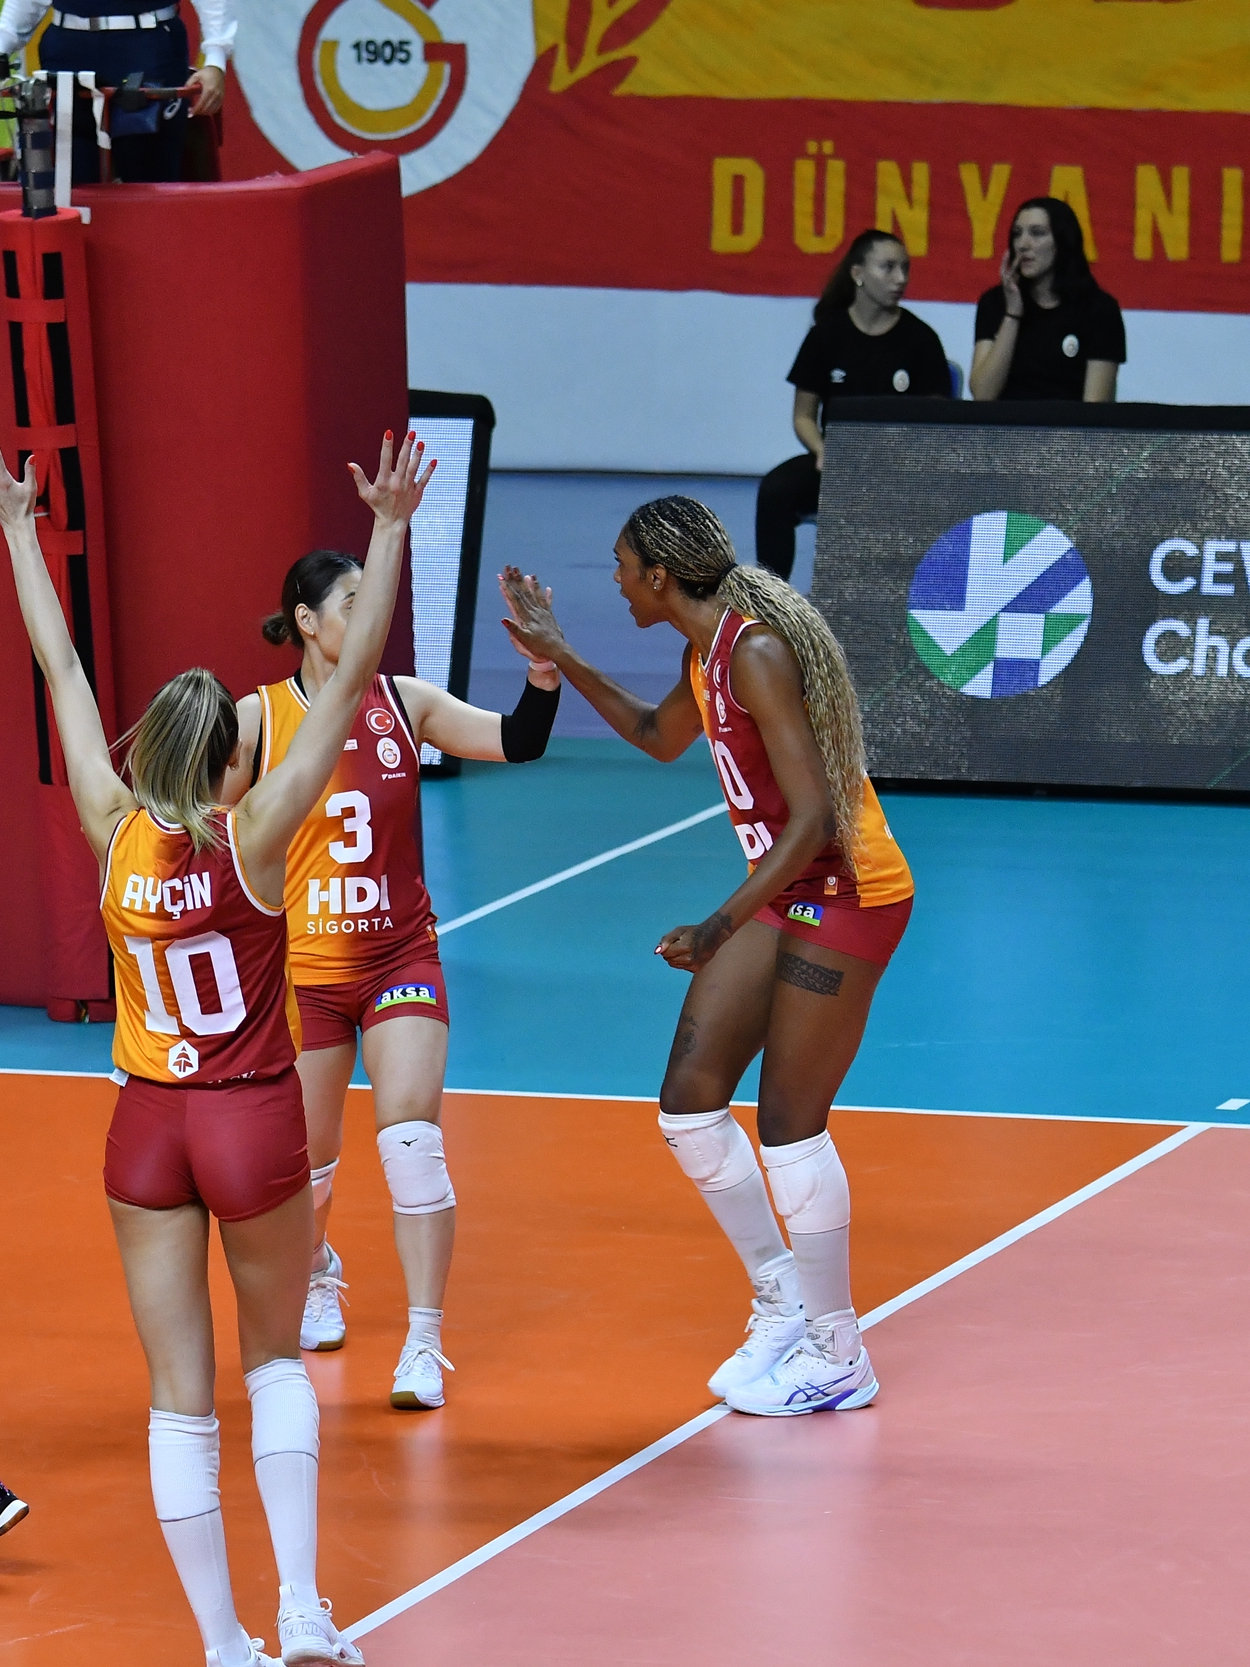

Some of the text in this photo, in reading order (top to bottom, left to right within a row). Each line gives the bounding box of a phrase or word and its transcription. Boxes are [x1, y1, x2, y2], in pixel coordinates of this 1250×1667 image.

[352, 39, 412, 66] 1905
[707, 737, 754, 811] 0
[325, 790, 372, 864] 3
[121, 871, 212, 920] AYÇİN
[307, 874, 391, 915] HDI
[306, 916, 394, 934] SİGORTA
[123, 930, 247, 1036] 10
[381, 986, 431, 1005] aksa
